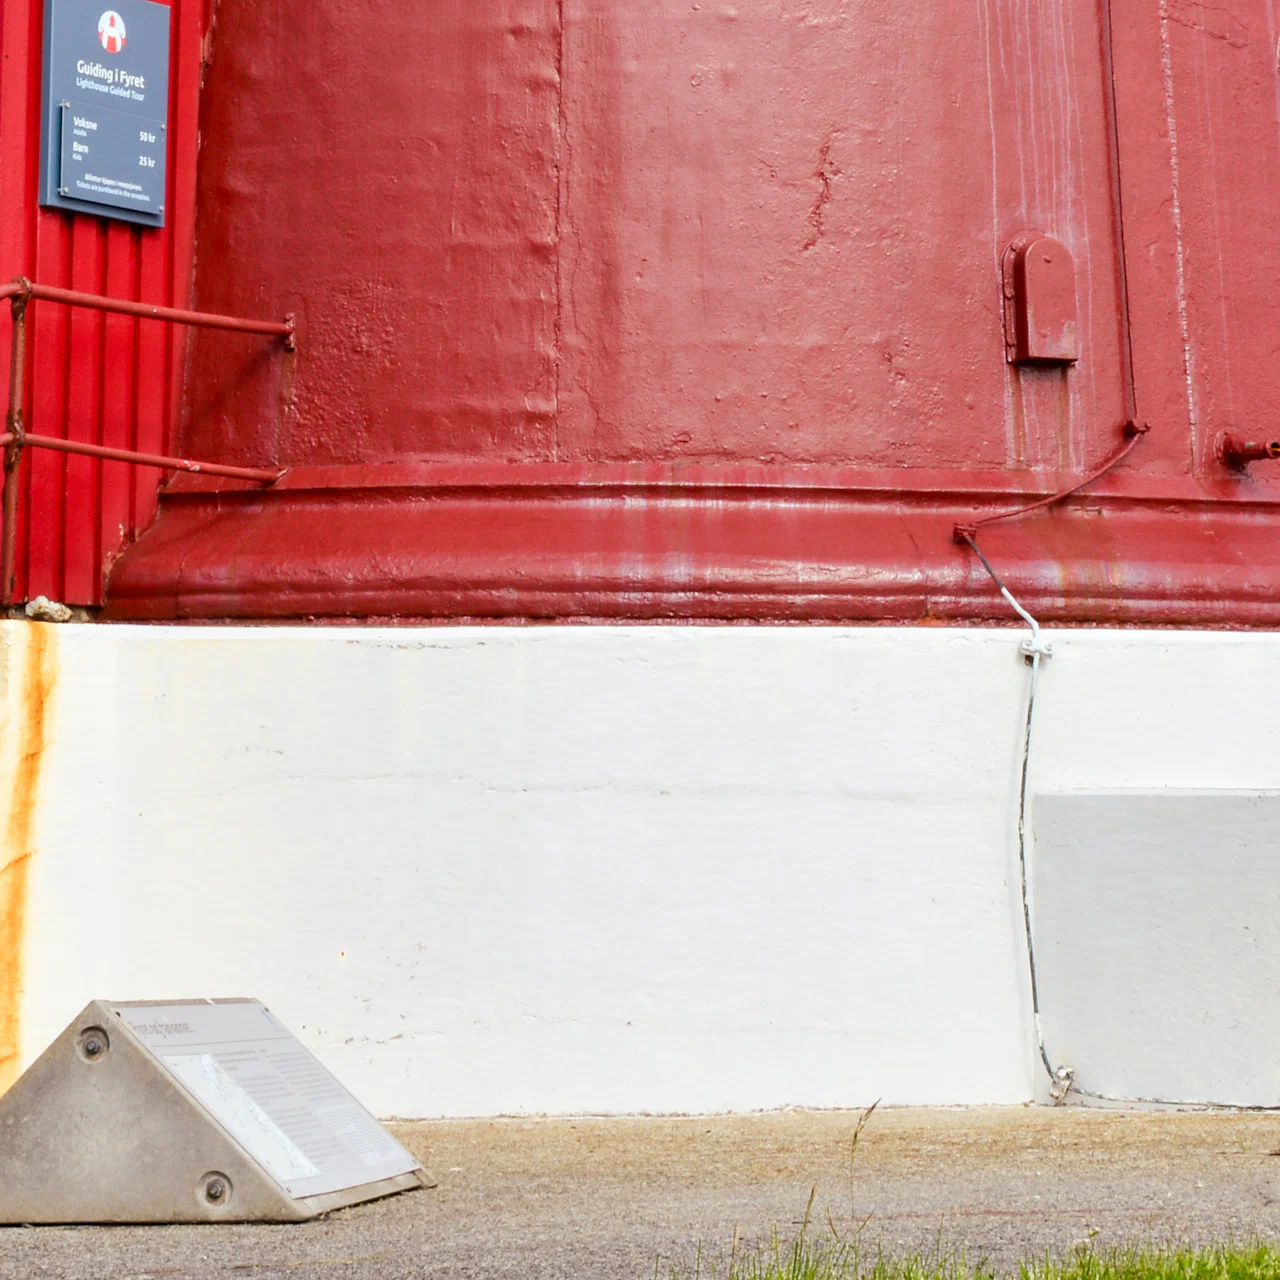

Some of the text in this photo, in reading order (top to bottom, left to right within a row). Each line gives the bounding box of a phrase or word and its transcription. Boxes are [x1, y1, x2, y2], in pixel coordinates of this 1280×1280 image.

[77, 60, 145, 88] Guiding i Fyret
[76, 77, 145, 101] Lighthouse Guided Tour
[73, 116, 97, 130] Voksne
[73, 128, 87, 137] Adults
[139, 131, 156, 143] 50 kr
[73, 141, 89, 153] Barn
[72, 153, 82, 161] Kids
[139, 156, 156, 167] 25 kr
